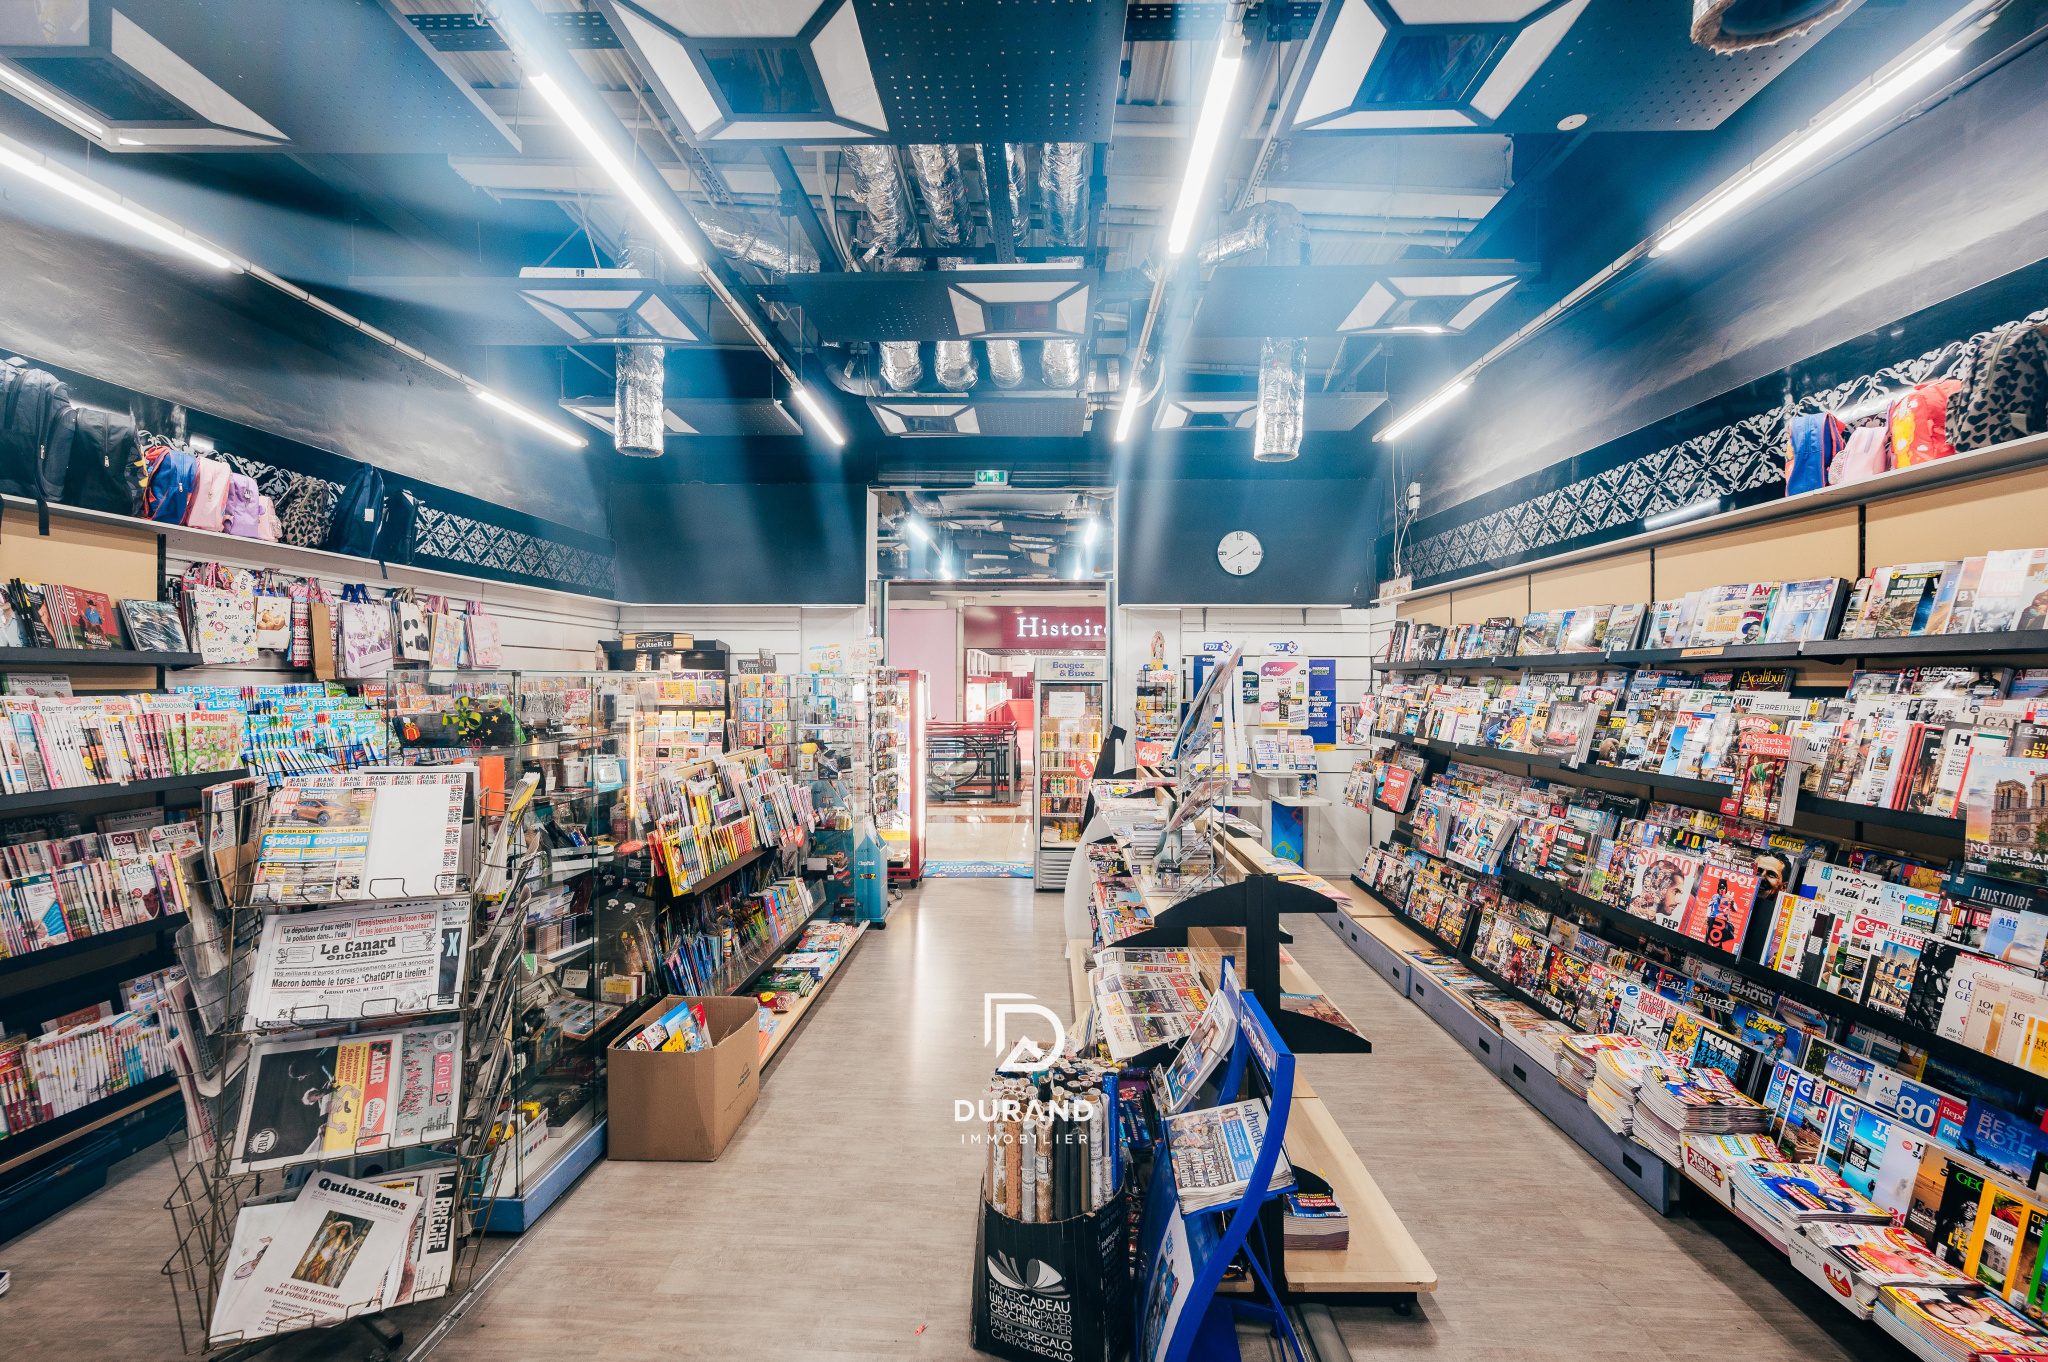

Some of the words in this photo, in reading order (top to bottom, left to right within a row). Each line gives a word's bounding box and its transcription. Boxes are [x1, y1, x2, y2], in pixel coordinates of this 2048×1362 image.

[1897, 579, 1908, 588] De
[1909, 579, 1918, 588] la
[1776, 594, 1831, 611] NASA
[1053, 661, 1085, 670] Bougez
[1741, 669, 1785, 688] Excalibur
[191, 711, 229, 723] Pâques
[1511, 721, 1526, 735] 90
[1738, 717, 1774, 732] RAIDS
[1751, 734, 1783, 745] Secrets
[1752, 743, 1789, 755] d'Histoire
[1807, 742, 1819, 751] AU
[2022, 749, 2046, 758] DES
[300, 791, 338, 800] Sandero
[161, 827, 189, 838] Atelier
[264, 835, 311, 847] Spécial
[314, 834, 368, 844] occasion
[1975, 853, 2001, 864] Passion
[1707, 868, 1720, 879] LE
[357, 917, 397, 928] Enregistrements
[398, 914, 416, 922] Buisson
[1662, 918, 1679, 929] PEP
[291, 925, 319, 934] dépollueur
[320, 924, 334, 932] d'eau
[335, 922, 352, 930] rejette
[374, 925, 402, 935] journalistes
[292, 933, 316, 942] pollution
[335, 930, 347, 938] l'eau
[320, 944, 339, 955] Le
[345, 937, 396, 953] Canard
[335, 963, 386, 974] d'investissements
[407, 958, 434, 966] annoncés
[272, 978, 300, 987] Macron
[301, 978, 326, 987] bombe
[336, 976, 354, 985] torse
[396, 971, 402, 979] la
[404, 968, 427, 978] tirelire
[1756, 1017, 1787, 1034] SPORT
[1702, 1030, 1742, 1058] KULT
[1895, 1095, 1935, 1128] 80
[1979, 1114, 2032, 1140] BEST
[1693, 1148, 1716, 1175] Télé
[1850, 1152, 1867, 1165] NEW
[1850, 1159, 1865, 1171] YORK
[1177, 1154, 1192, 1188] indienne
[1204, 1148, 1221, 1187] Marseille
[318, 1178, 407, 1211] Quinzaines
[1989, 1227, 2002, 1240] 100
[310, 1289, 340, 1300] BATTANT
[310, 1296, 346, 1309] IRANIENNE
